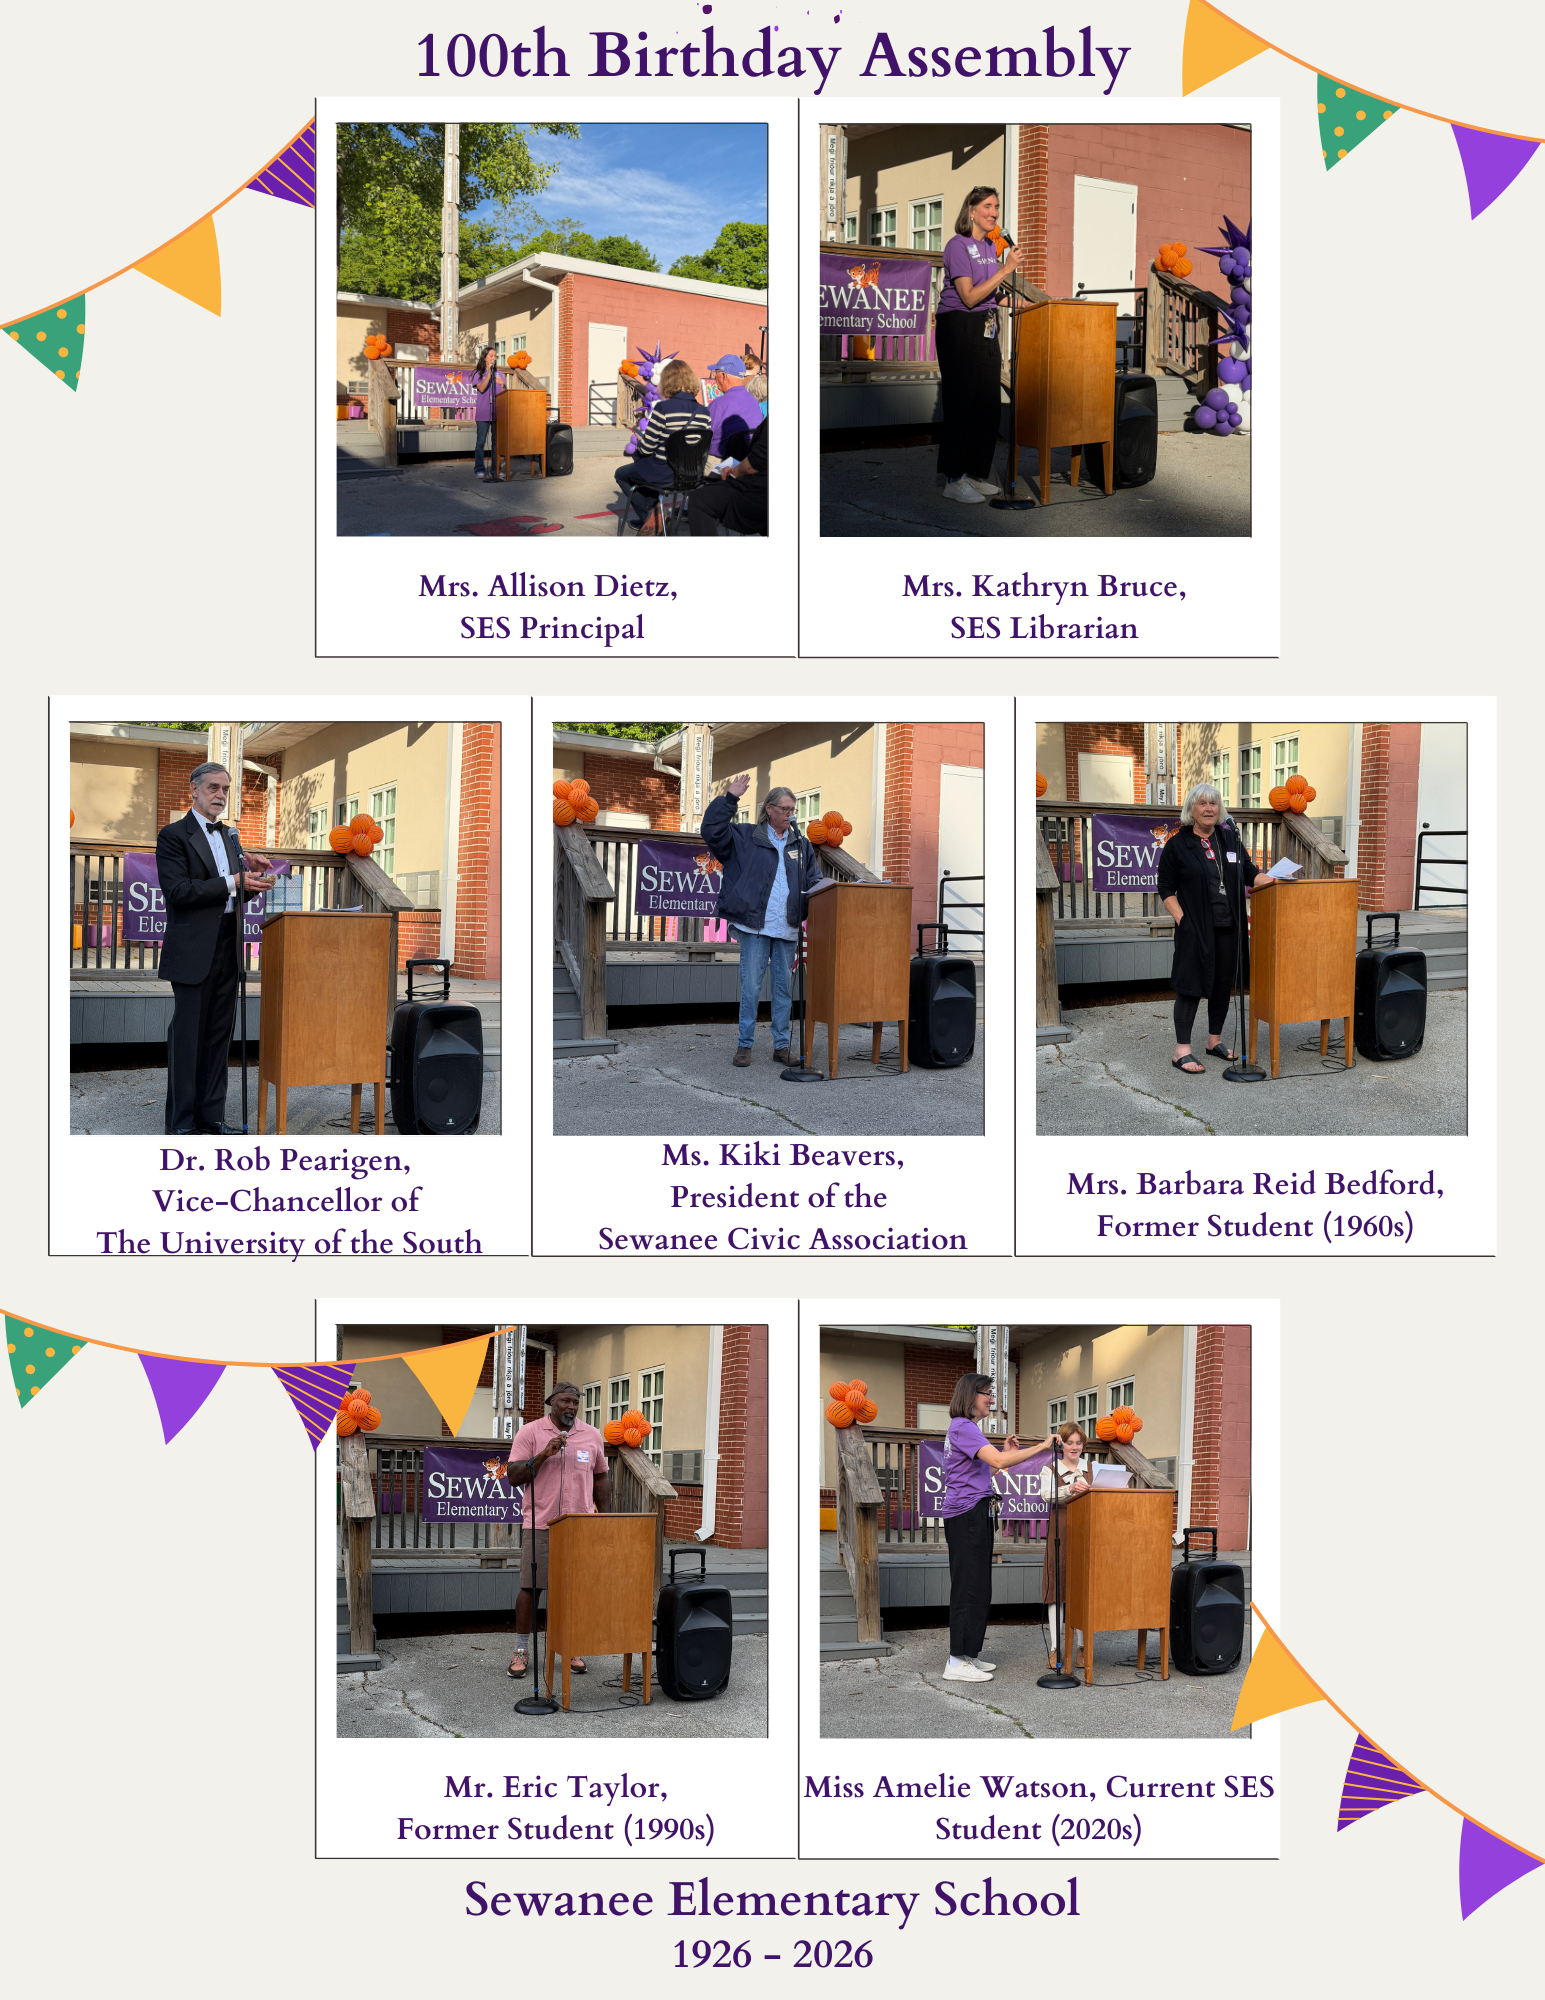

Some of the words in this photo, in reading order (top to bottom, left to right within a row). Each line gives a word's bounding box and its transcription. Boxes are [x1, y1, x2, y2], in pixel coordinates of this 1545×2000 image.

[877, 313, 917, 329] School
[421, 395, 460, 405] Elementary
[649, 894, 717, 914] Elementary
[437, 1501, 508, 1520] Elementary
[1008, 1498, 1049, 1513] School
